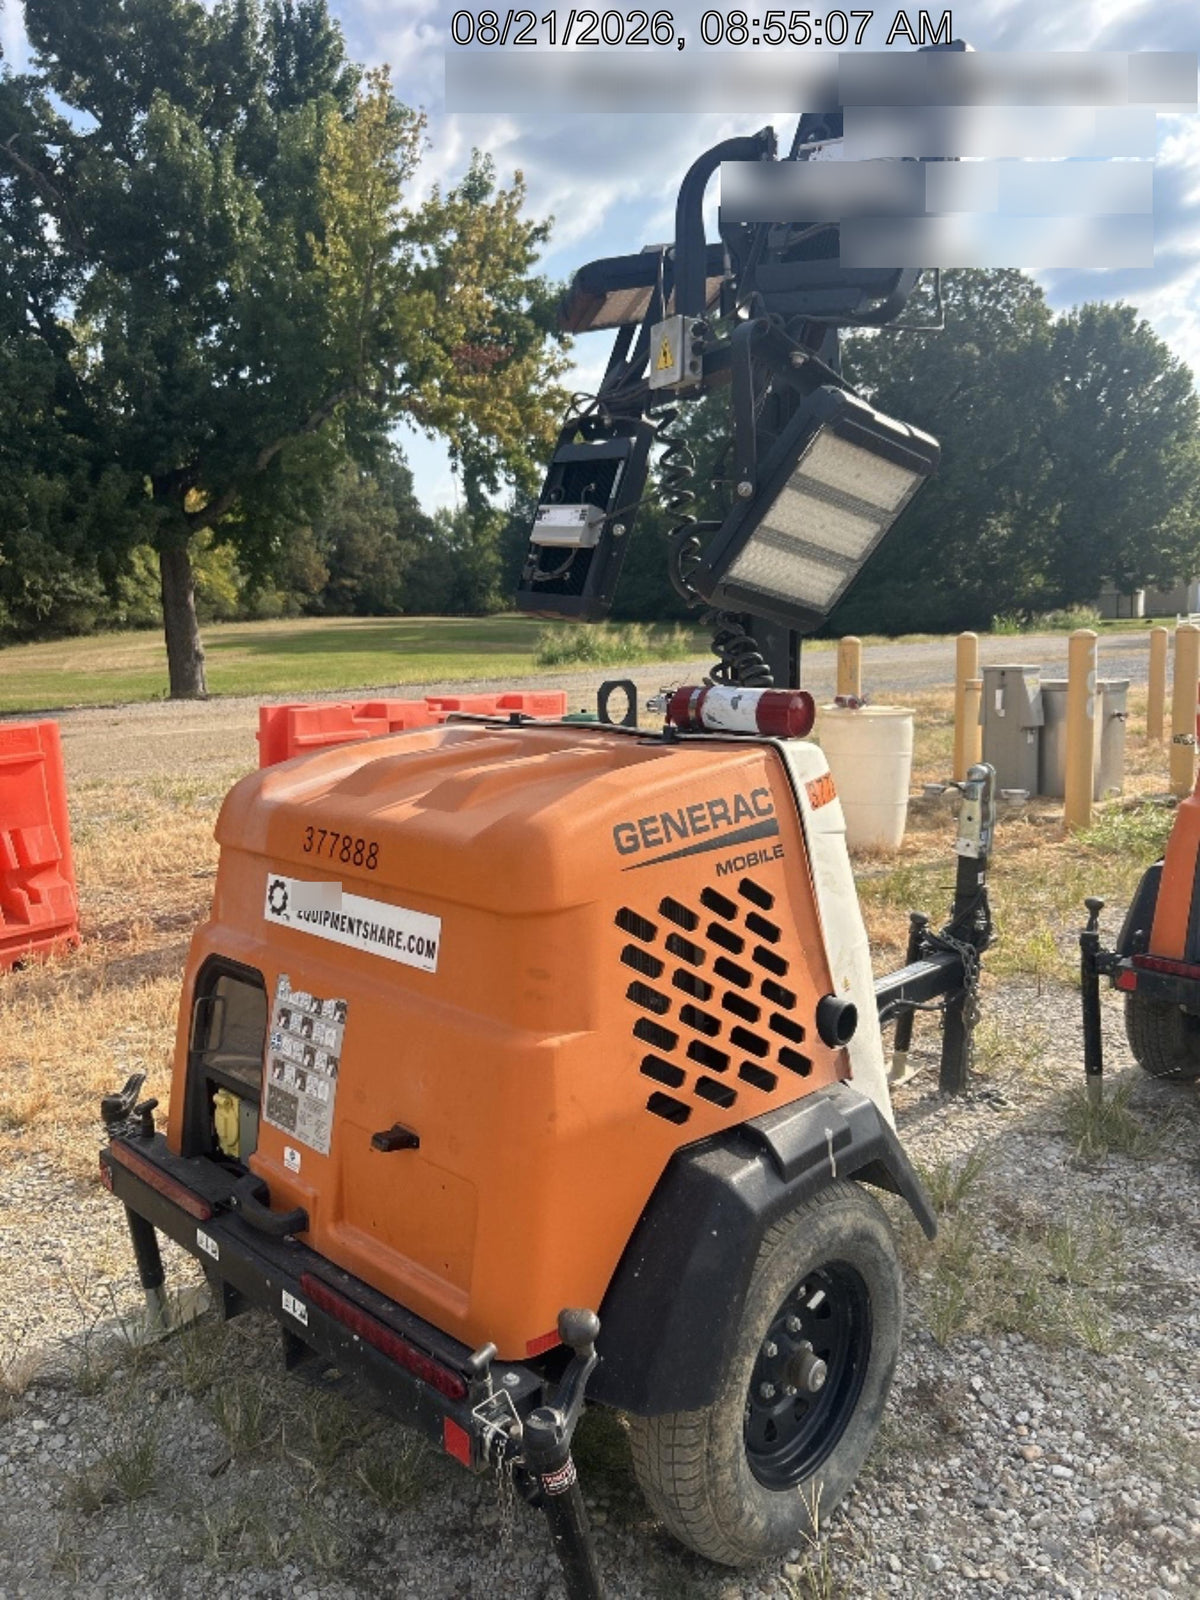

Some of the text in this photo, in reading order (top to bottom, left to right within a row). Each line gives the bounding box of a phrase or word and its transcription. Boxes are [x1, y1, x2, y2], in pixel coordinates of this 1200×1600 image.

[613, 788, 774, 855] GENERAC
[303, 826, 380, 870] 377888
[715, 844, 785, 877] MOBILE
